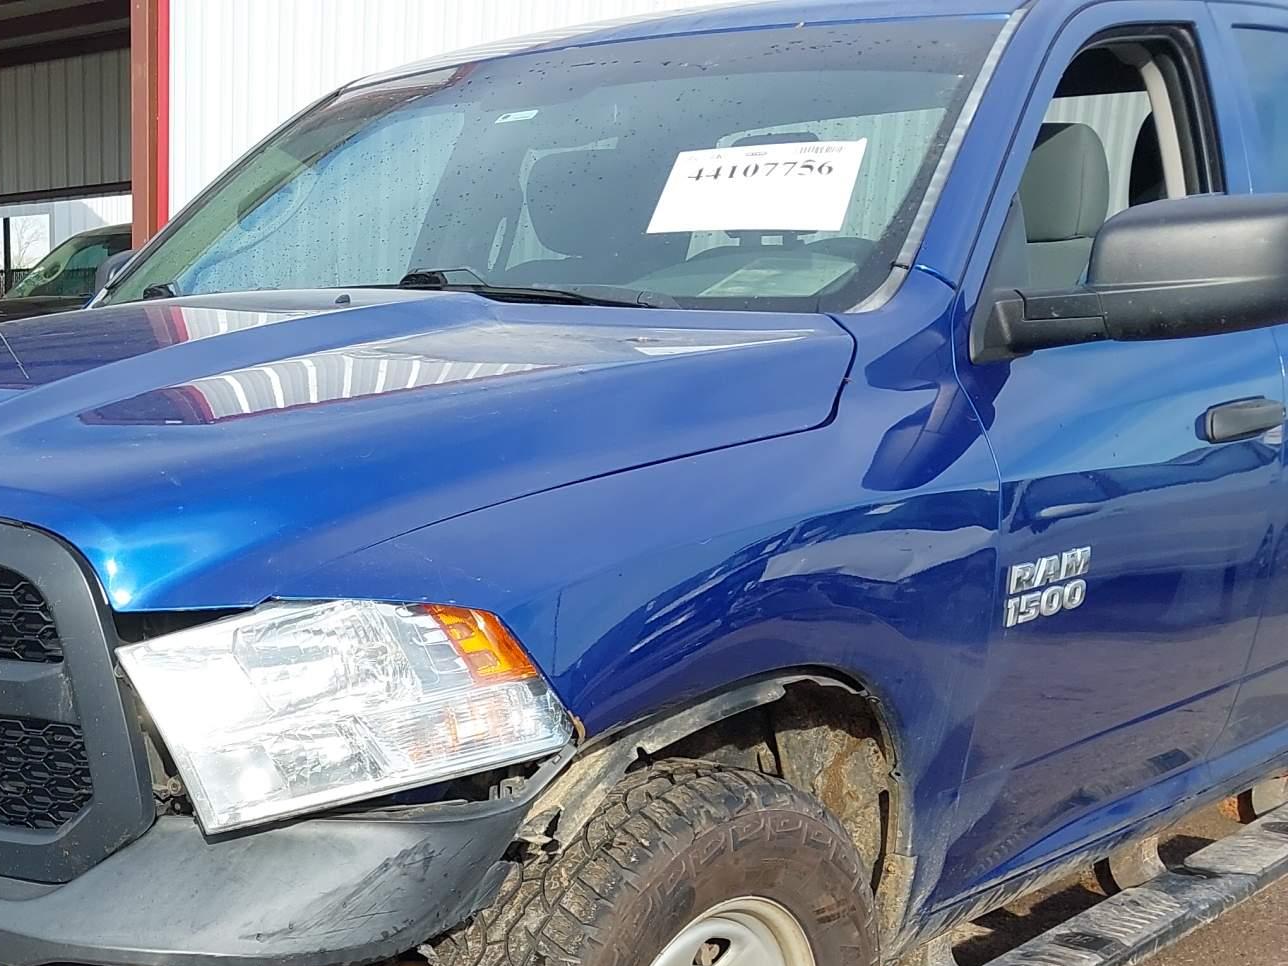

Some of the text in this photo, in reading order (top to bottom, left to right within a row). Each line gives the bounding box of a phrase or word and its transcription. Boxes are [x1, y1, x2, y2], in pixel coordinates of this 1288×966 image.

[687, 159, 834, 182] 44107756
[1007, 546, 1092, 595] RAM
[1003, 578, 1087, 628] 1500
